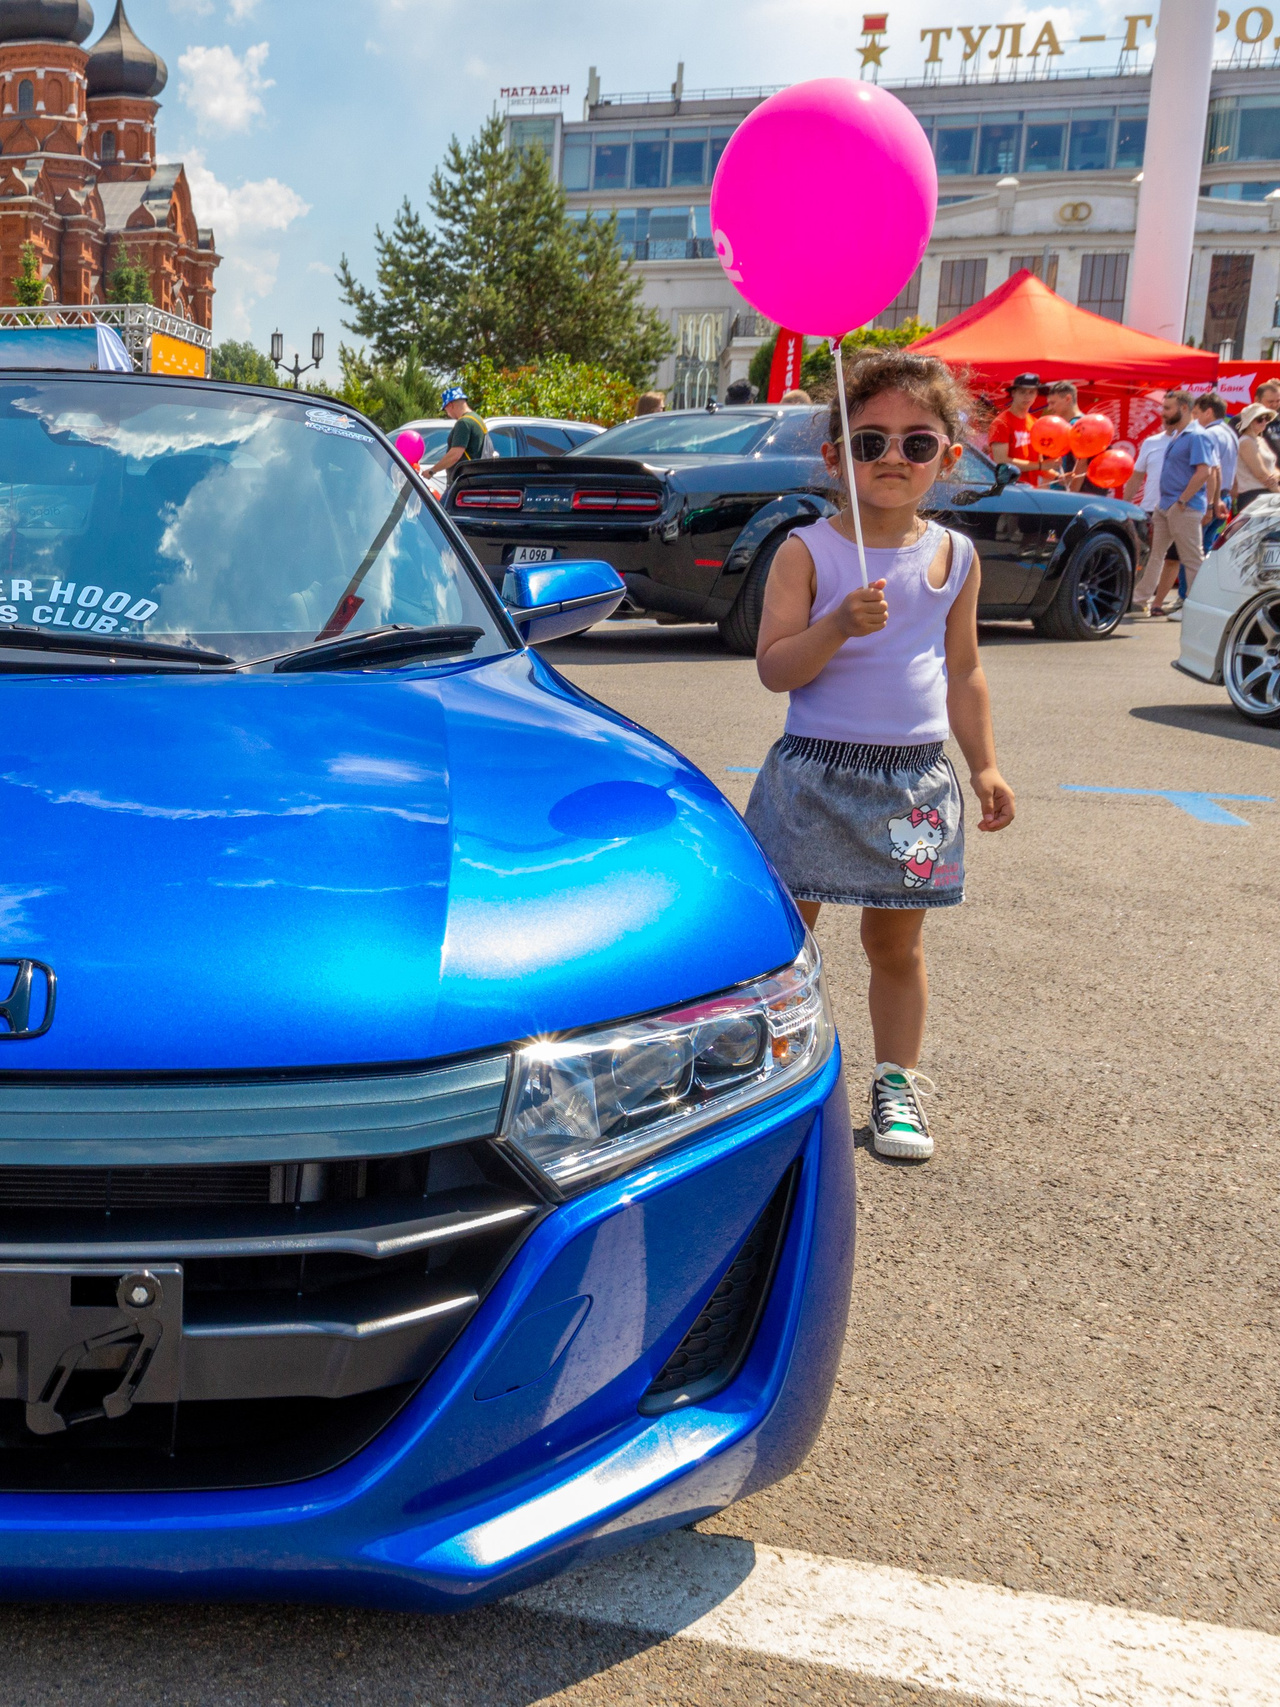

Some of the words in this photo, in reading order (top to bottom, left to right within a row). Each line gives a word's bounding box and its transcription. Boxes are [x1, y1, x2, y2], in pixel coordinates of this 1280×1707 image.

[920, 20, 1065, 62] ТУЛА
[500, 84, 570, 98] МАГАДАН
[1220, 383, 1244, 393] Банк
[529, 549, 548, 561] 098
[49, 581, 159, 621] HOOD
[32, 605, 118, 634] CLUB
